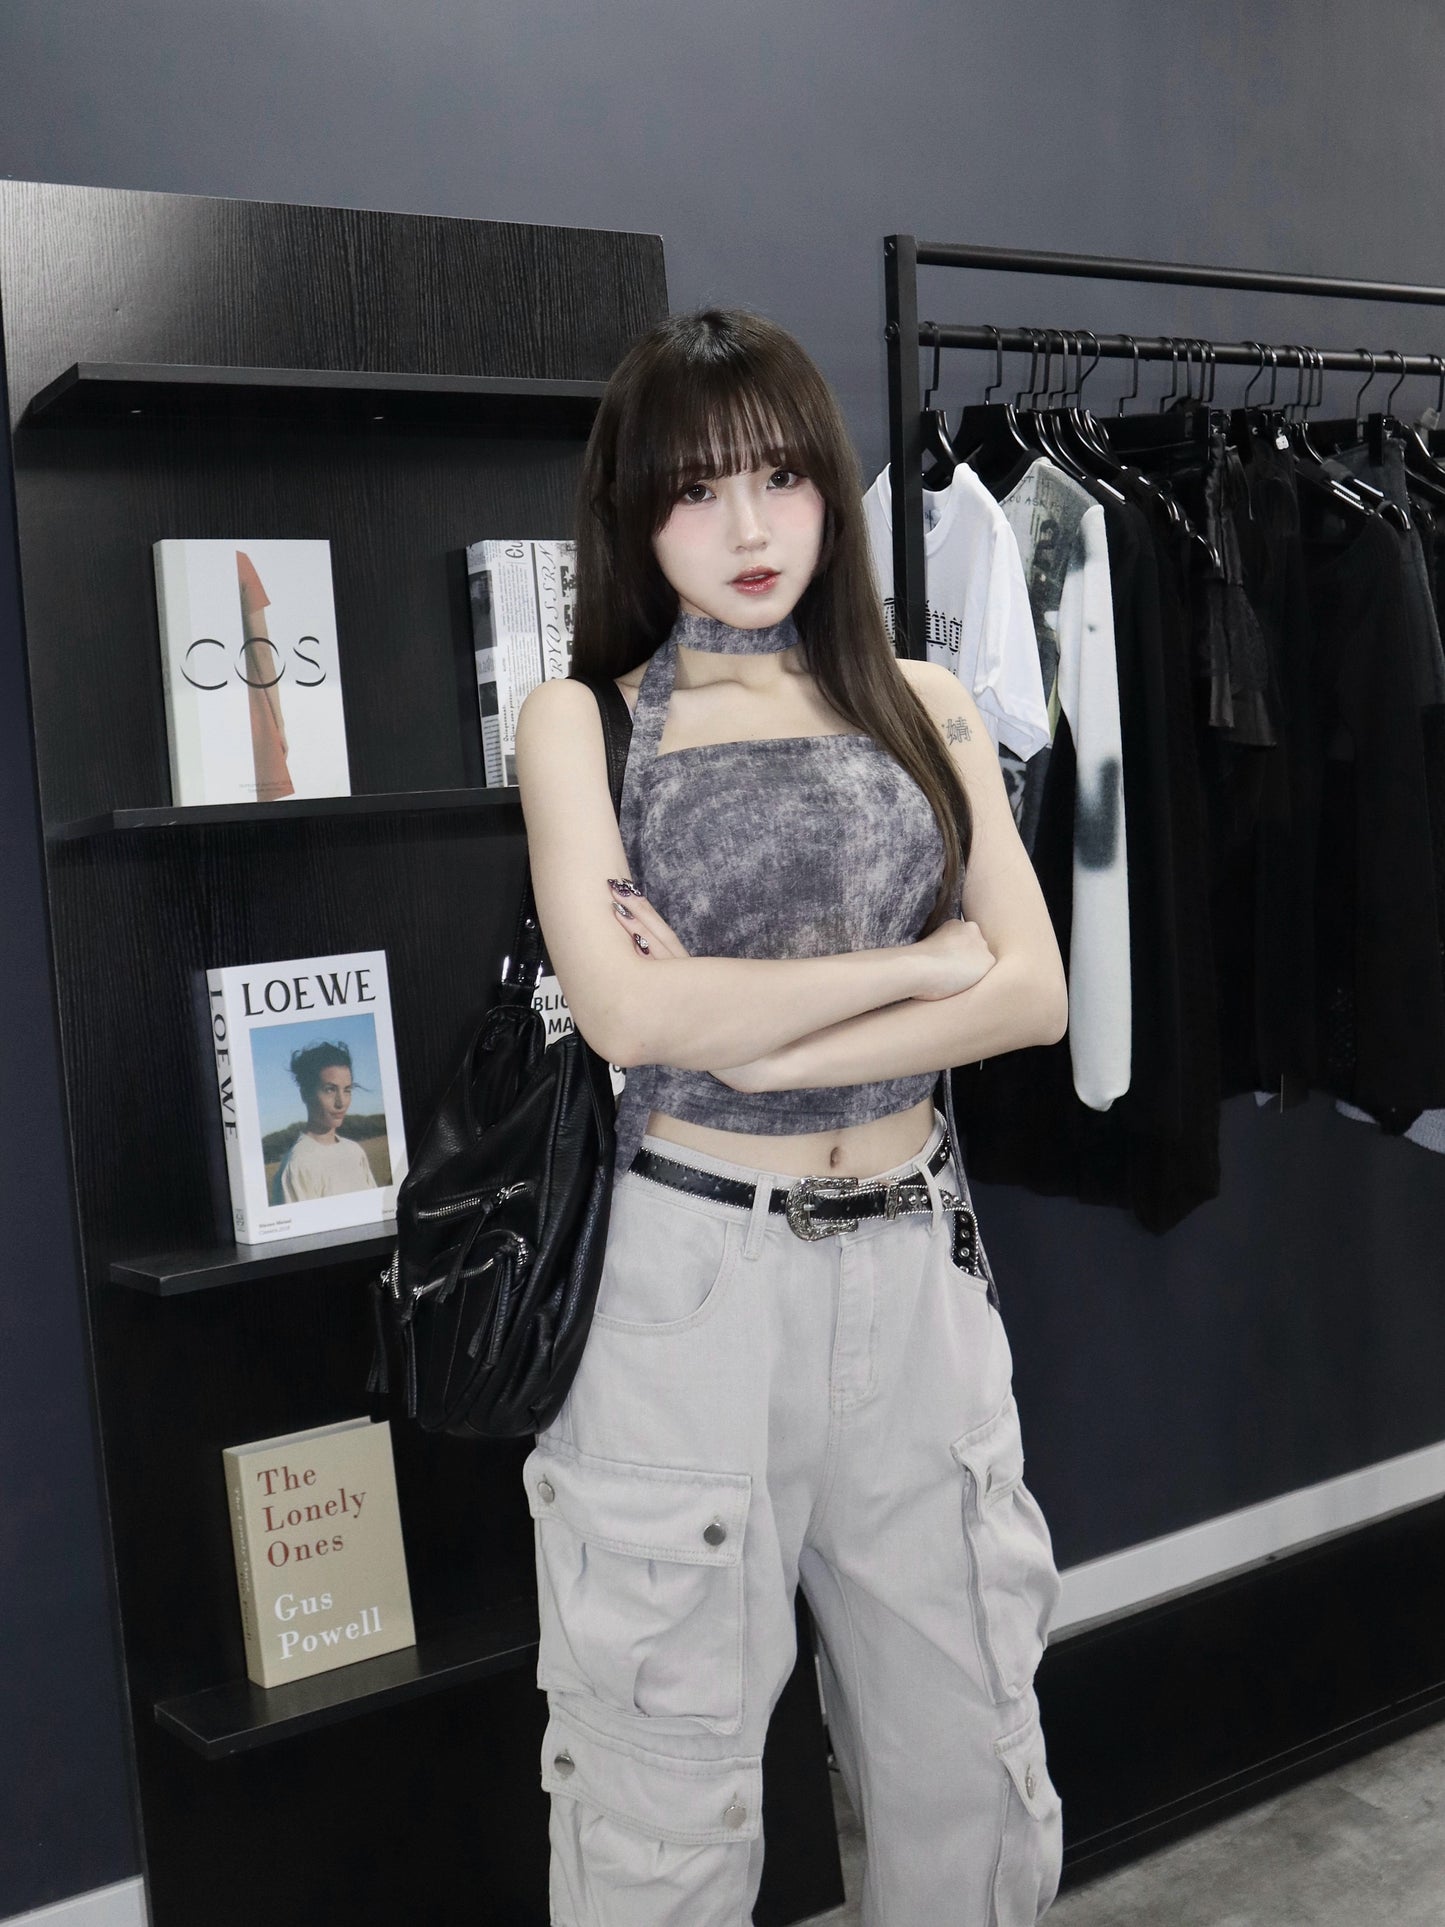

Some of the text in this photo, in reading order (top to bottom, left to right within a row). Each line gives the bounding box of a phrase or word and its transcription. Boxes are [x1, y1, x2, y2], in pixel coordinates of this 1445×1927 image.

[180, 635, 327, 691] COS
[241, 968, 377, 1017] LOEWE
[209, 989, 239, 1142] LOEWE
[257, 1465, 317, 1497] The
[261, 1487, 368, 1533] Lonely
[266, 1534, 345, 1568] Ones
[274, 1592, 334, 1622] Gus
[278, 1605, 384, 1661] Powell
